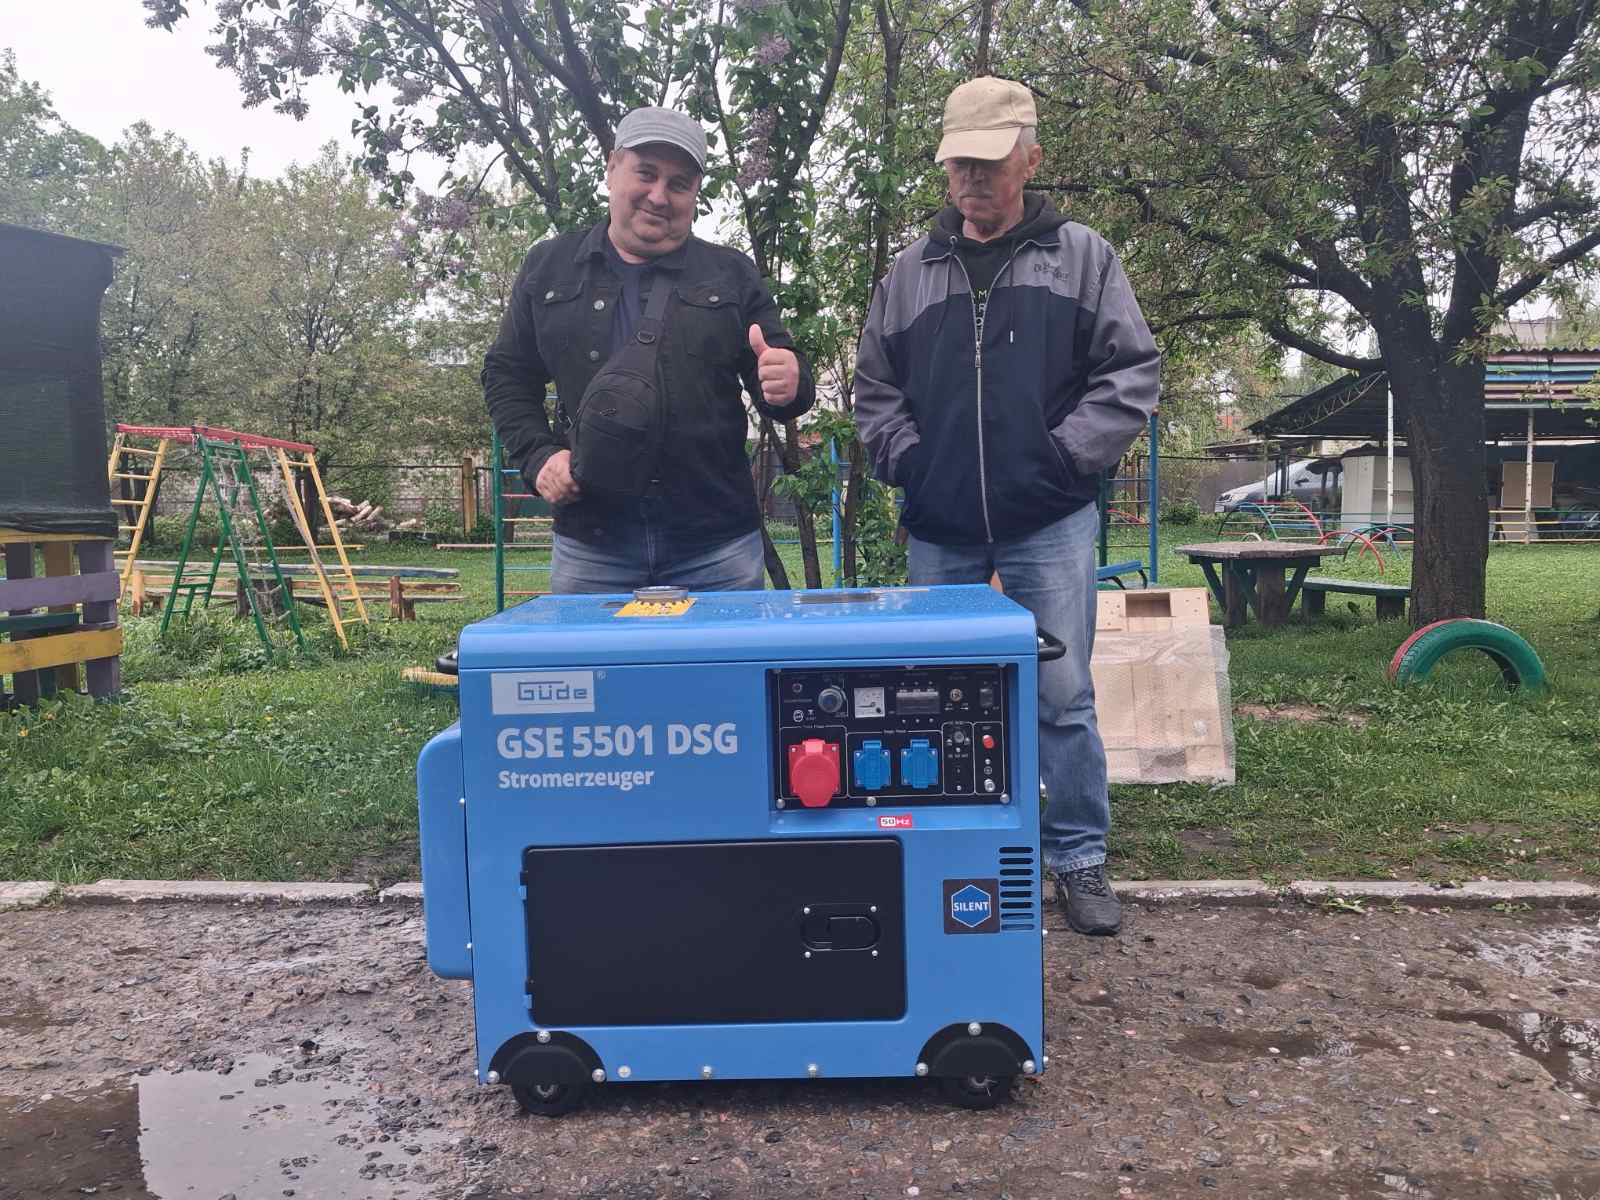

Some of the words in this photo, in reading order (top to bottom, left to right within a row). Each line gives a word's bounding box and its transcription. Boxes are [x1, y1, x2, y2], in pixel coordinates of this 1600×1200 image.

[517, 681, 588, 701] Güde
[496, 727, 565, 759] GSE
[572, 724, 654, 758] 5501
[666, 722, 738, 755] DSG
[498, 769, 655, 791] Stromerzeuger
[953, 901, 989, 912] SILENT
